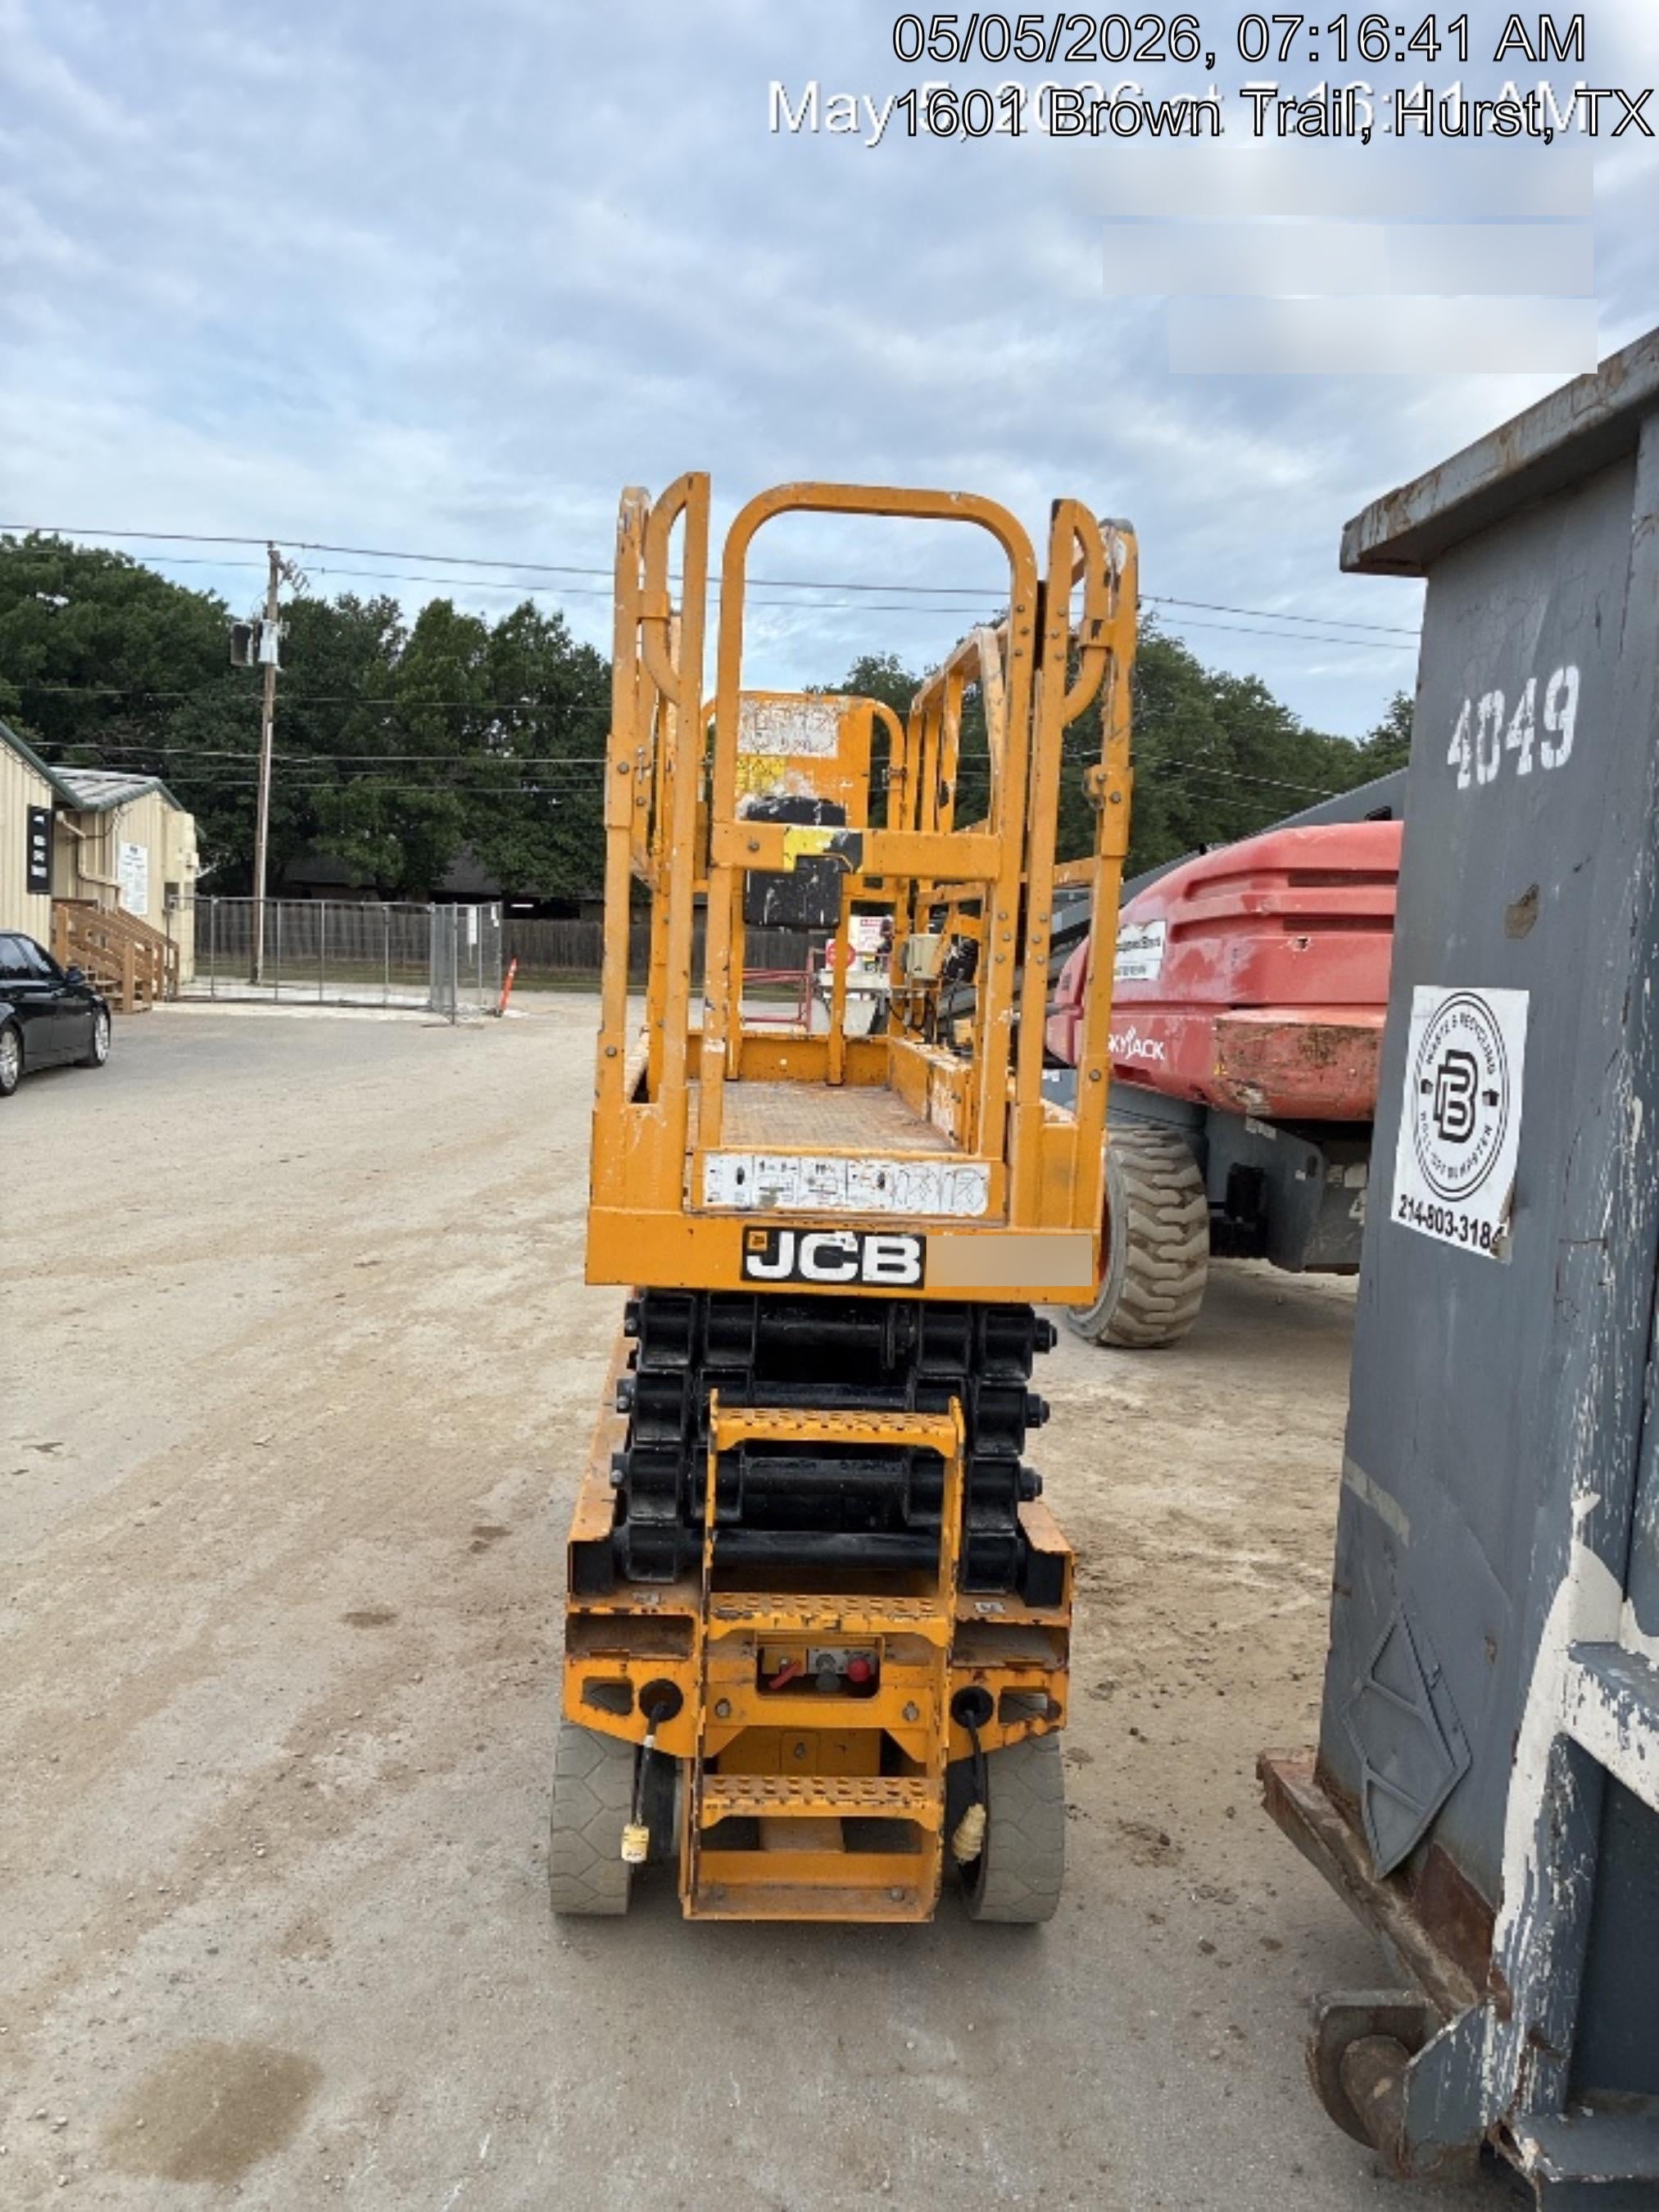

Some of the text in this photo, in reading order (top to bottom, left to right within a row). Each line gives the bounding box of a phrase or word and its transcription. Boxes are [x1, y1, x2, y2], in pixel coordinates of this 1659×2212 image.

[1447, 664, 1580, 790] 4049
[1108, 1026, 1166, 1060] KYJACK
[746, 1231, 921, 1285] JCB
